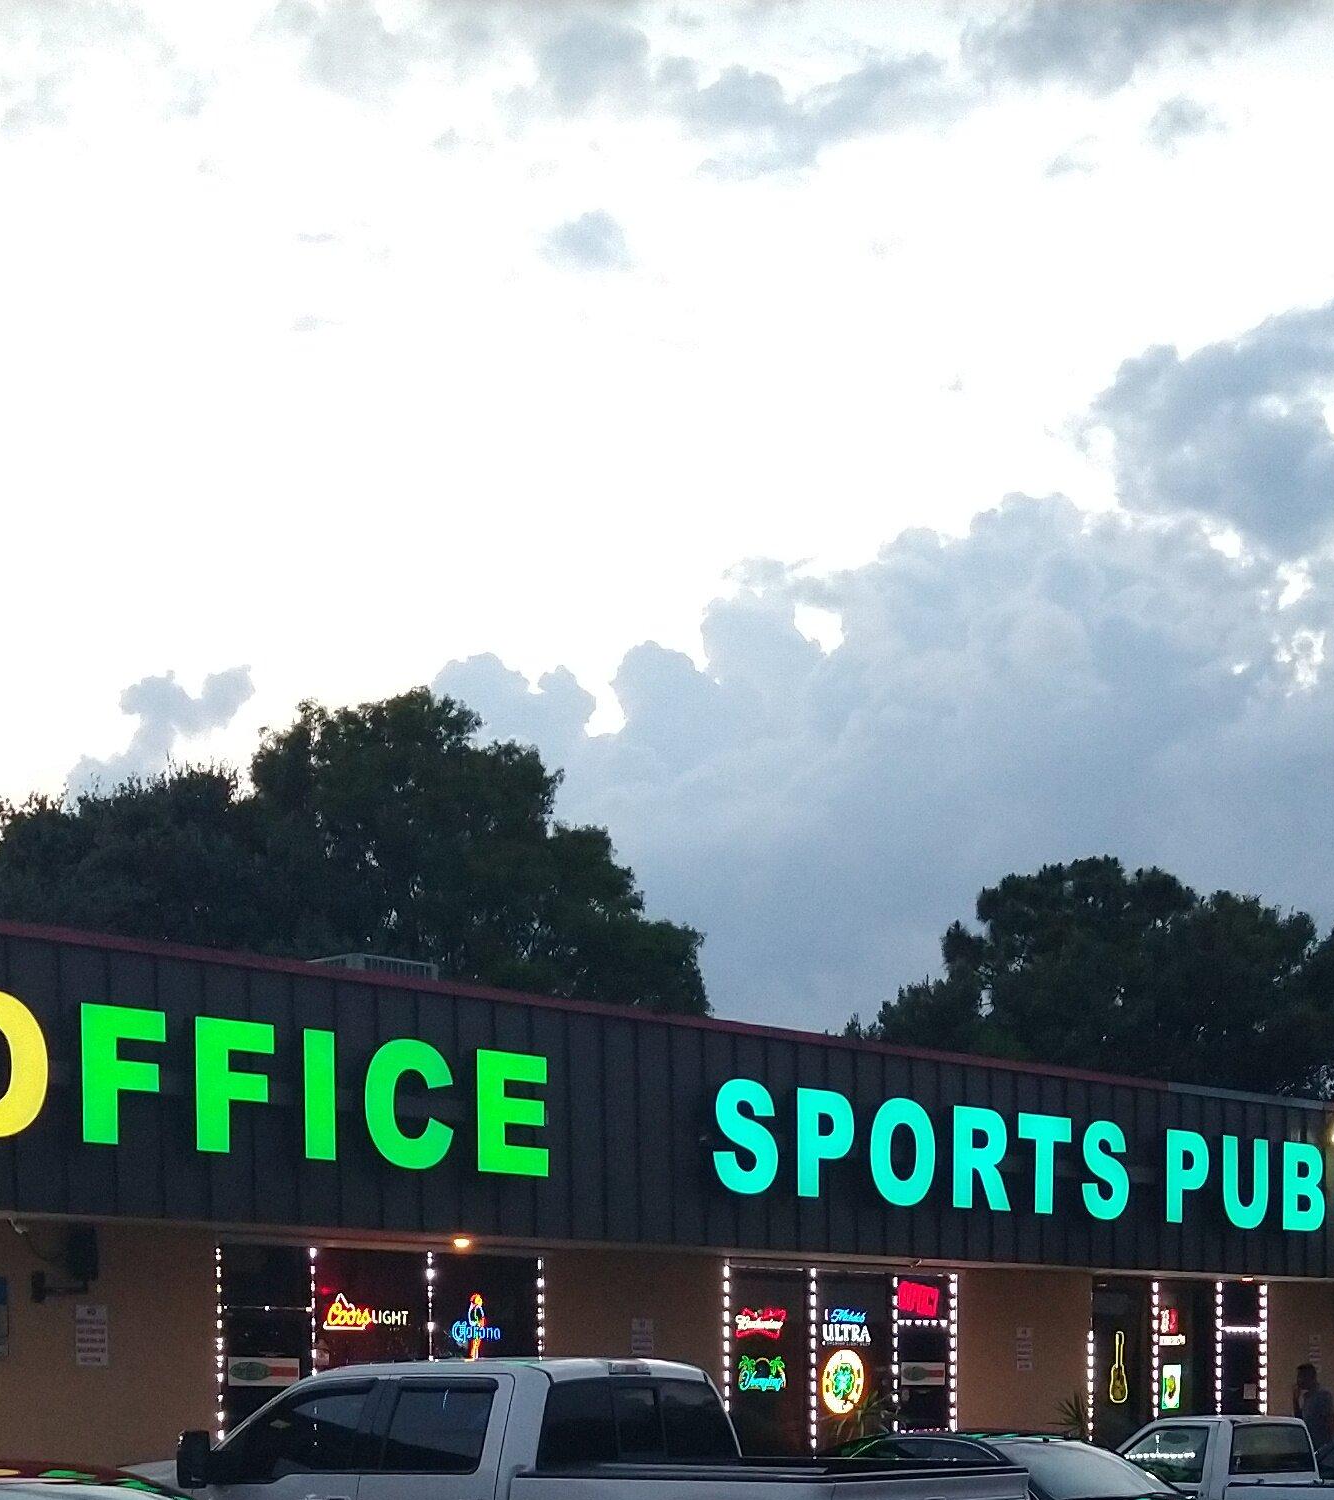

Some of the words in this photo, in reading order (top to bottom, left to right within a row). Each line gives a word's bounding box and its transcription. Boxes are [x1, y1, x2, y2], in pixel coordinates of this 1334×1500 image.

[712, 1078, 1130, 1221] SPORTS
[1165, 1128, 1327, 1232] PUB
[327, 1302, 373, 1326] Coors
[371, 1309, 409, 1326] LIGHT
[451, 1319, 502, 1345] Corona
[821, 1323, 872, 1343] ULTRA
